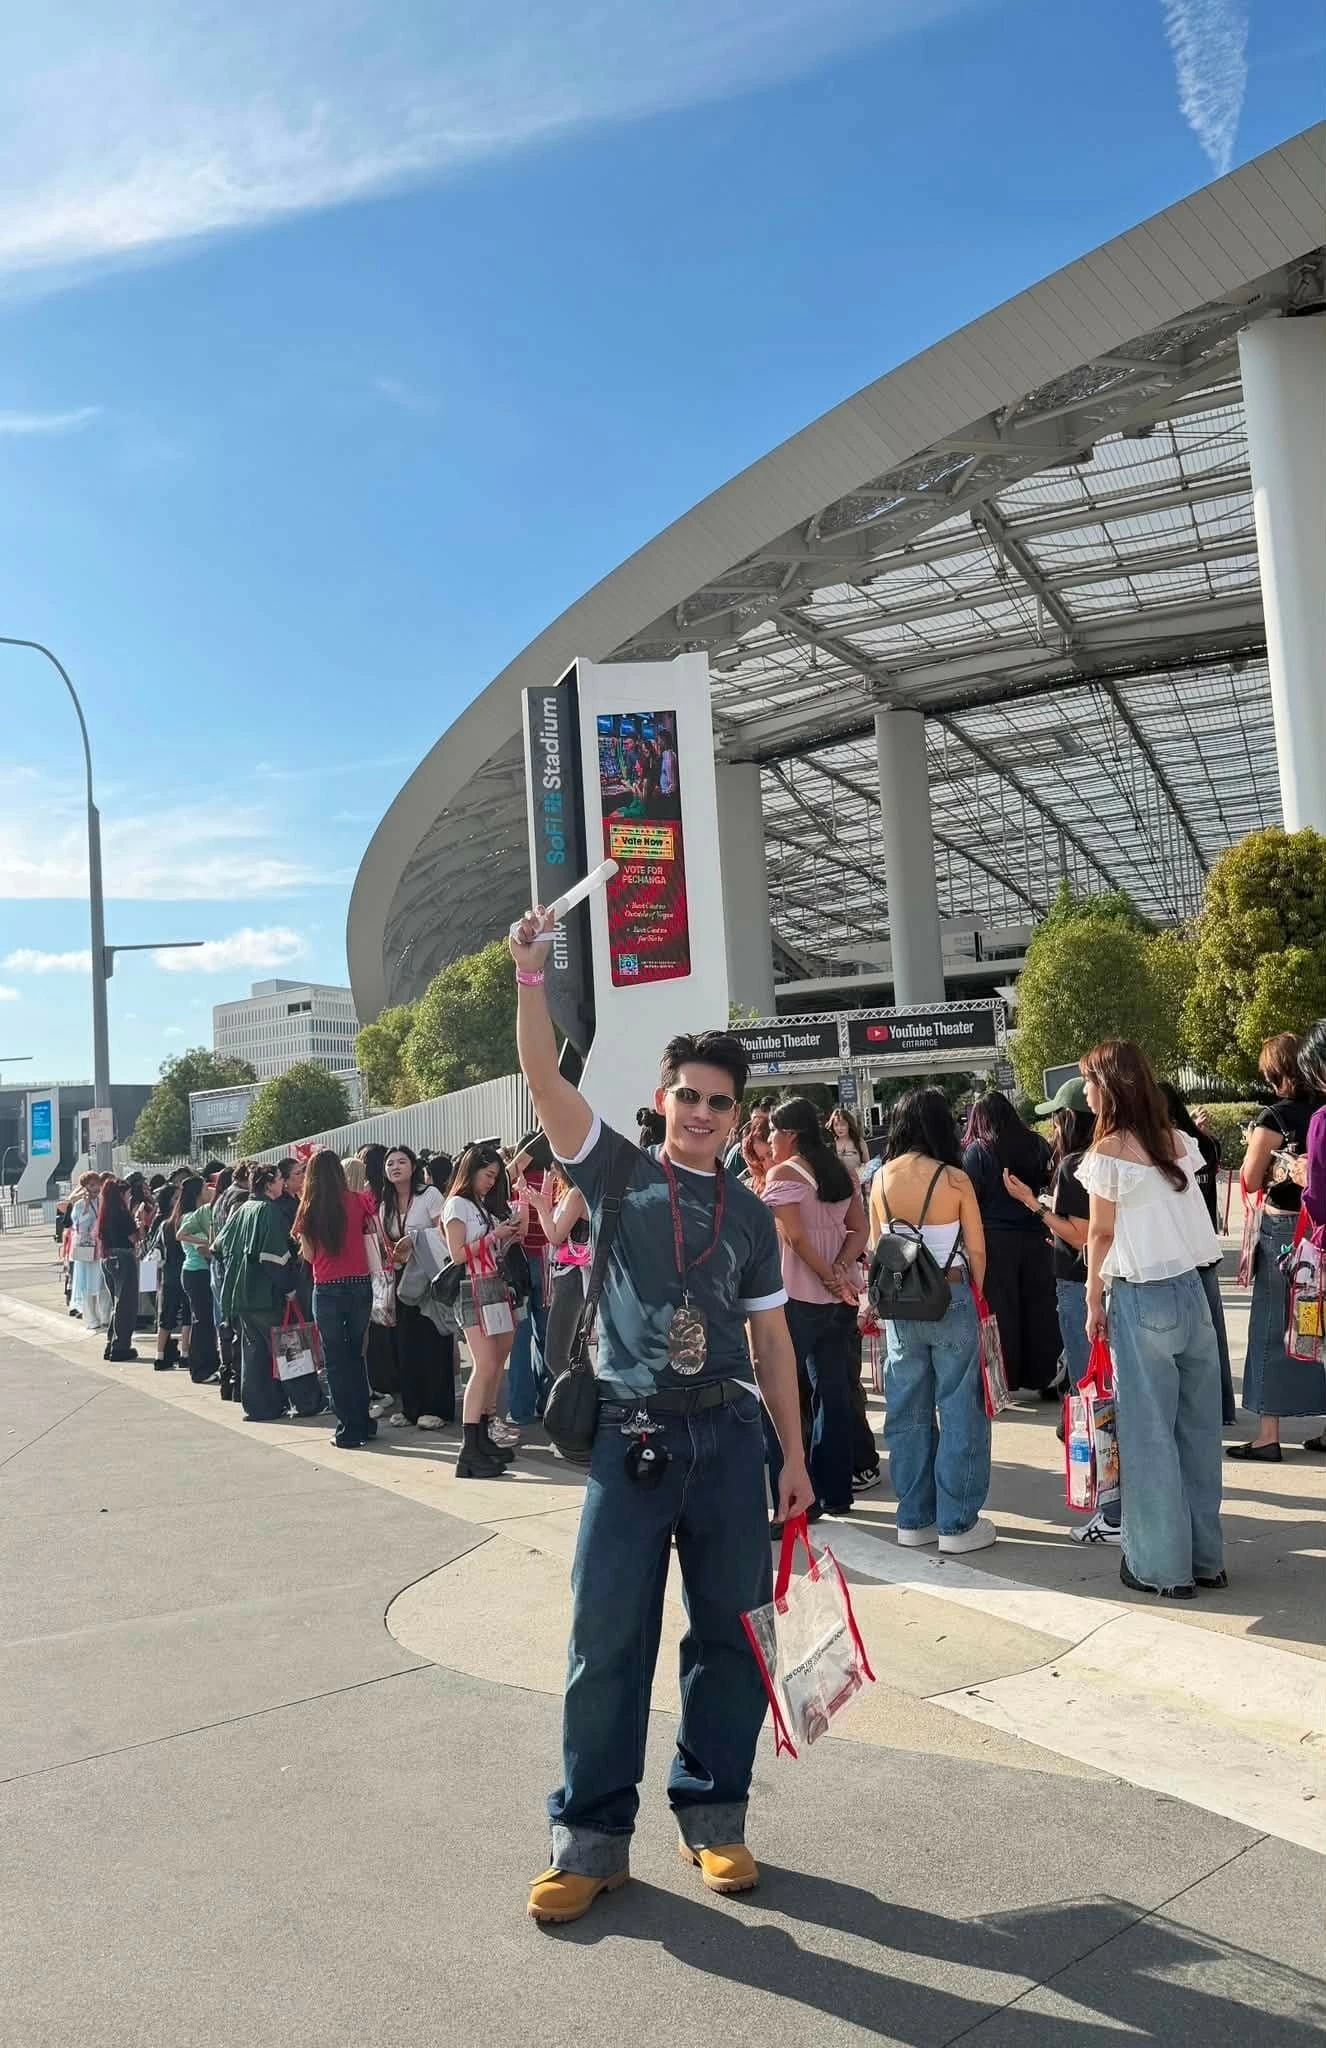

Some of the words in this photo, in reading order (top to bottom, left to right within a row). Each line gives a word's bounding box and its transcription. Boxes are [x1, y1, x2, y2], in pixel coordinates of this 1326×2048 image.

[539, 696, 562, 789] Stadium
[543, 816, 566, 865] SoFi
[621, 836, 642, 846] Vote
[643, 837, 664, 847] Now
[624, 865, 645, 874] VOTE
[647, 865, 664, 875] FOR
[622, 874, 667, 885] PECHANGA
[888, 1022, 932, 1039] YouTube
[932, 1021, 975, 1036] Theater
[739, 1035, 781, 1052] YouTube
[781, 1033, 821, 1048] Theater
[902, 1038, 938, 1049] ENTRANCE
[751, 1050, 787, 1061] ENTRANCE
